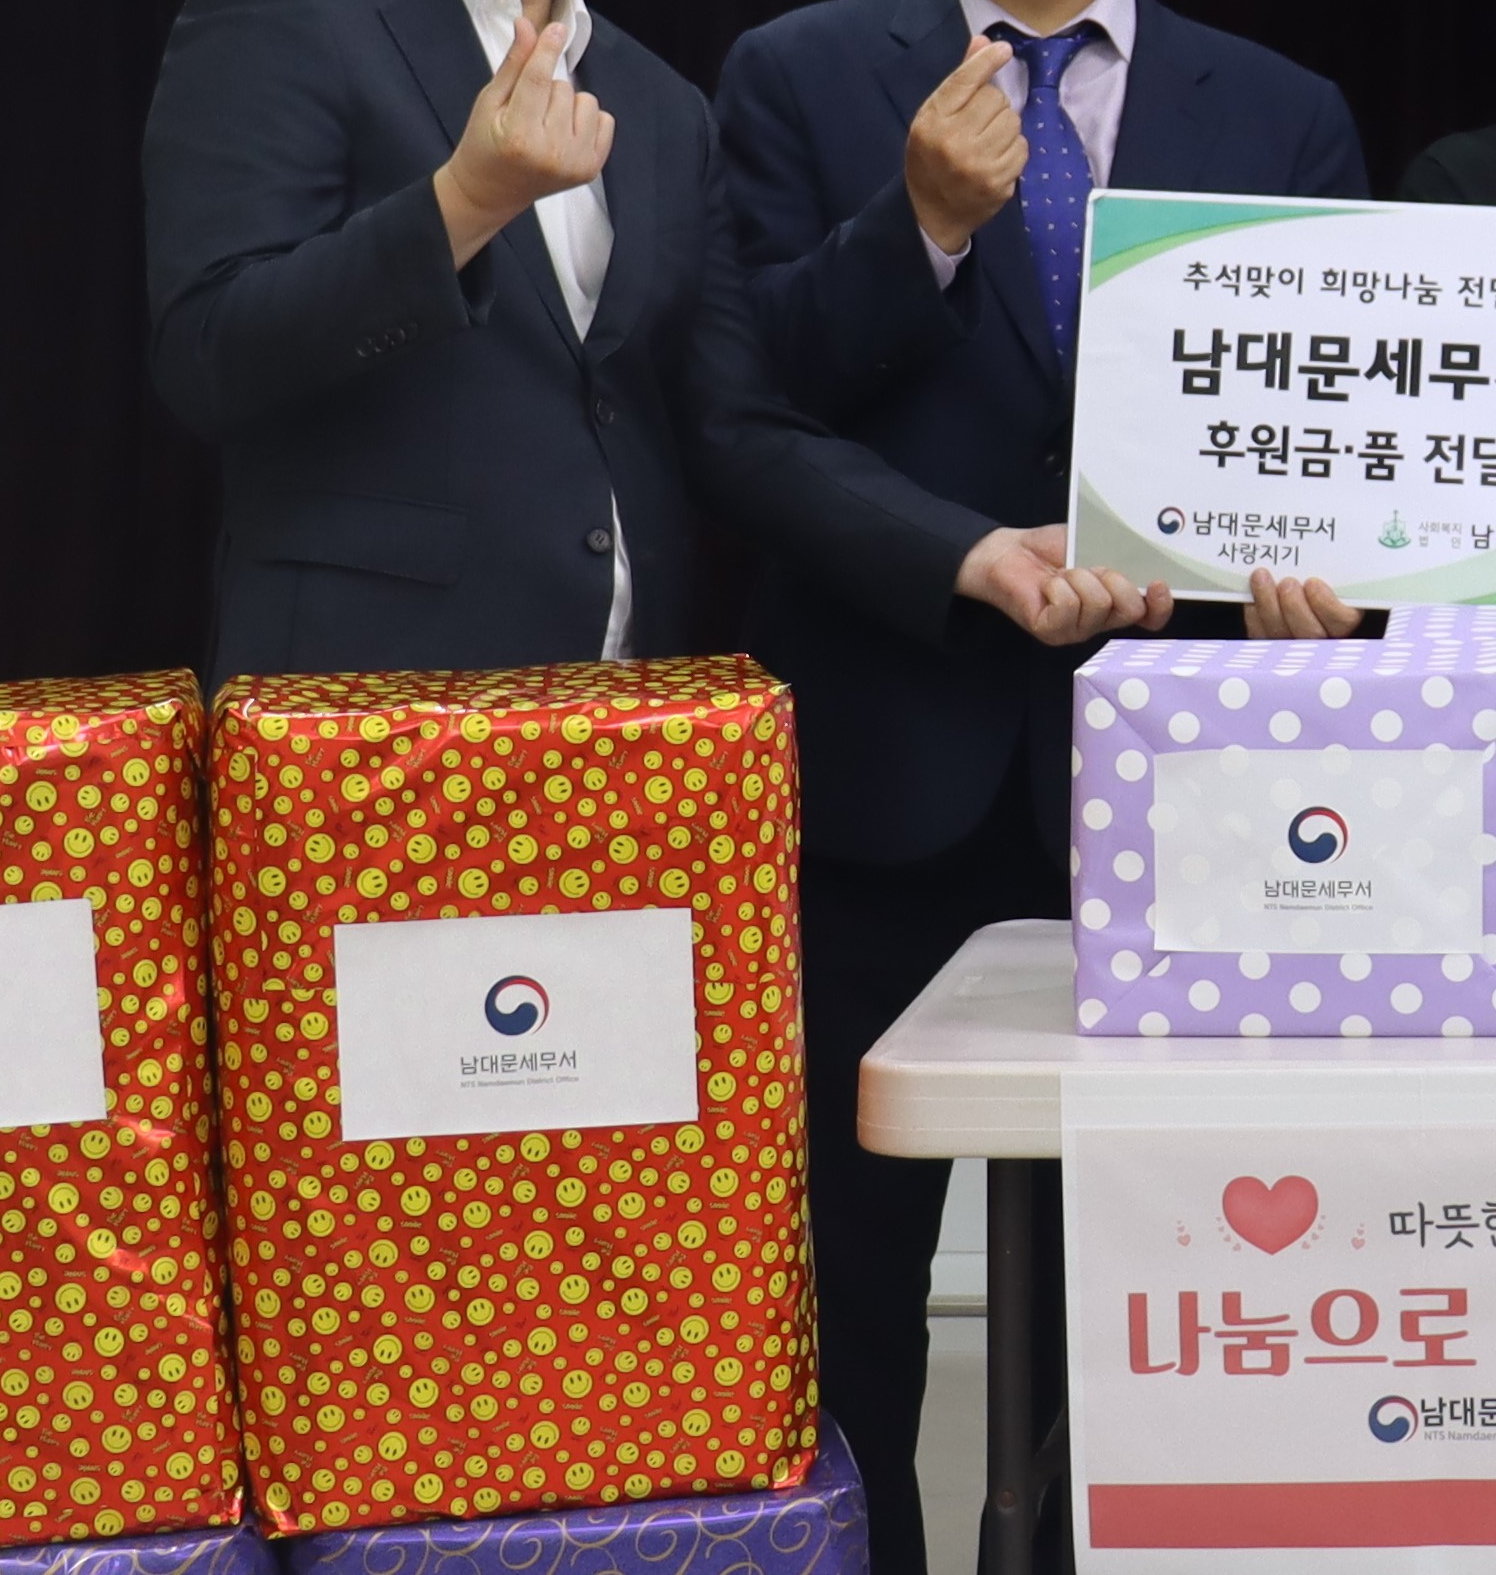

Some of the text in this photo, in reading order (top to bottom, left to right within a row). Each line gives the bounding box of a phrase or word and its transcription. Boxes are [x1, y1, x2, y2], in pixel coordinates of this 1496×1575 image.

[1184, 262, 1303, 298] 추석맞이
[1321, 269, 1441, 305] 희망나눔
[1193, 512, 1335, 541] 남대문세무서
[1218, 543, 1298, 566] 사랑지기
[1265, 880, 1371, 898] 남대문세무서
[461, 1051, 576, 1075] 남대문세무서
[1128, 1288, 1477, 1376] 나눔으로
[1424, 1431, 1445, 1441] NTS
